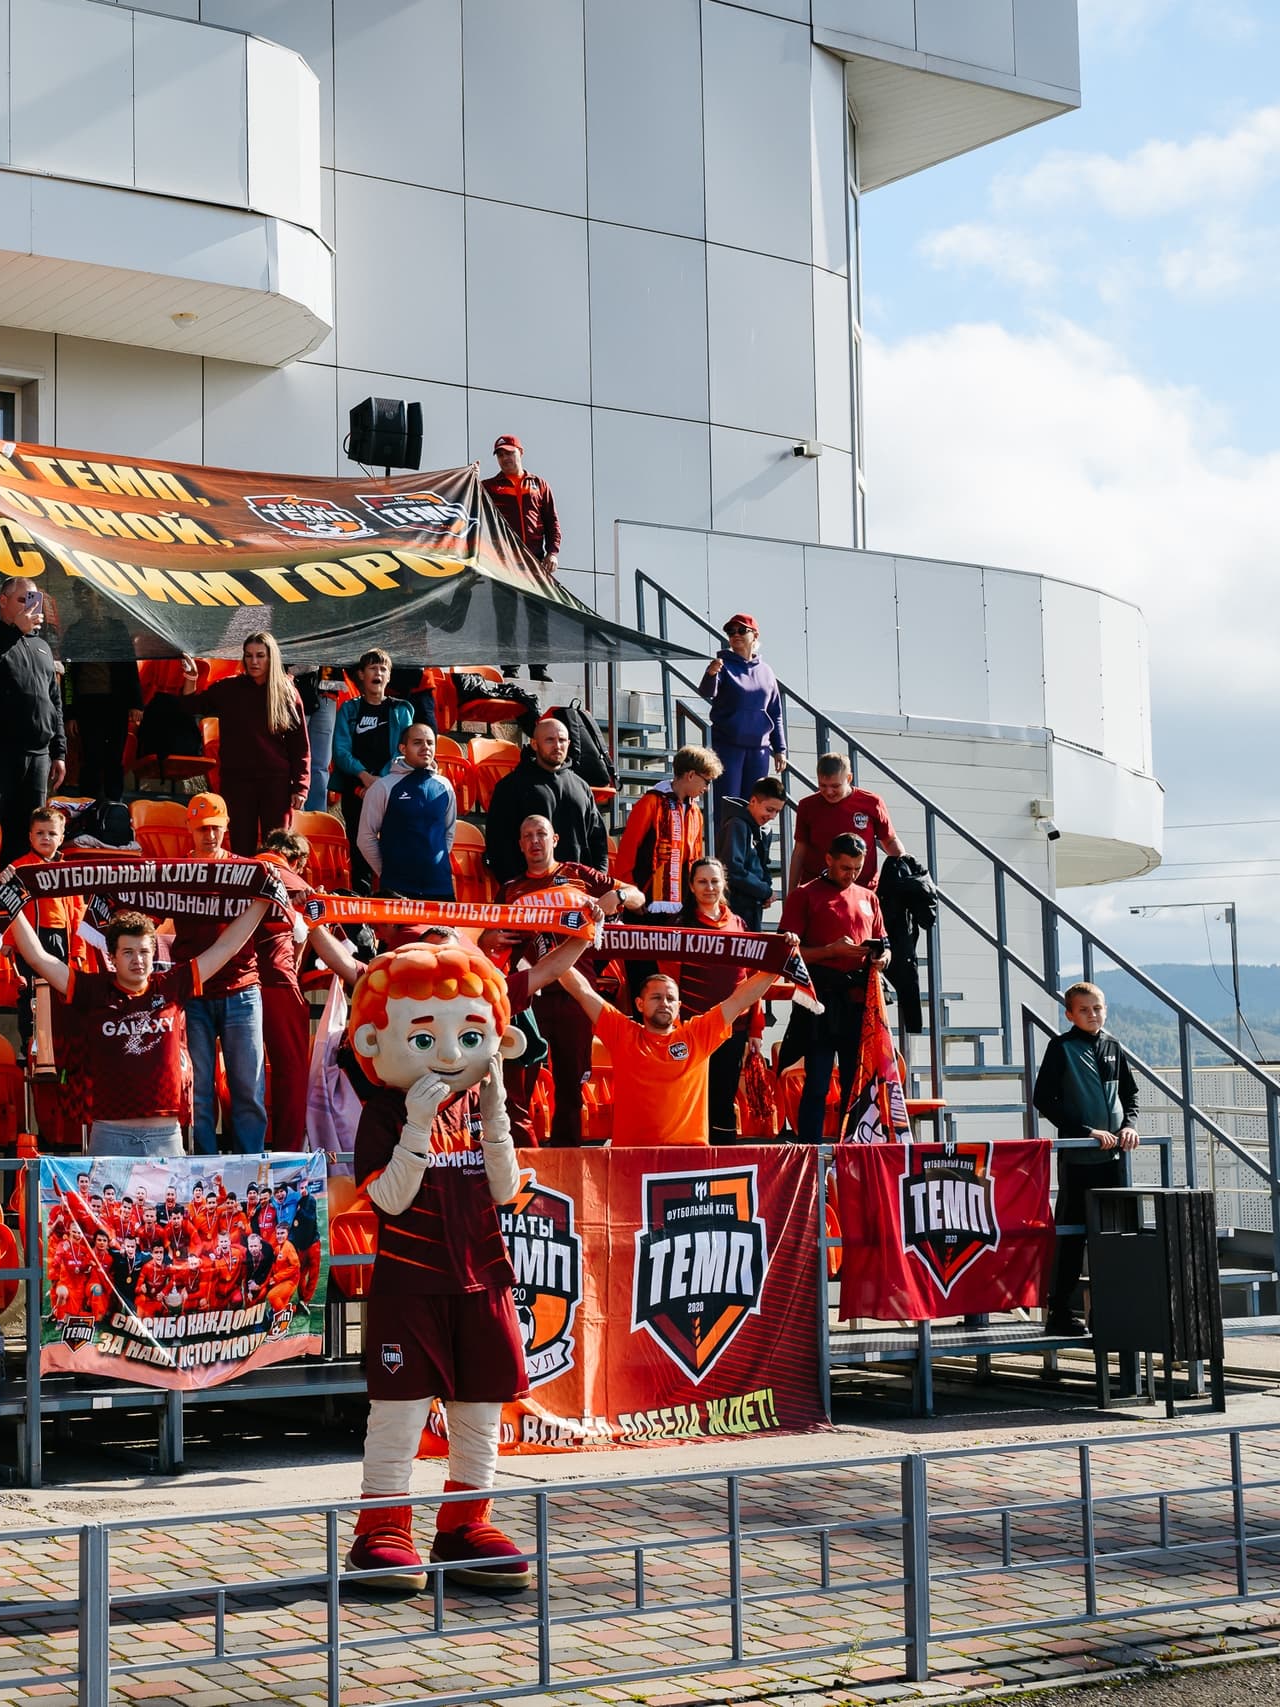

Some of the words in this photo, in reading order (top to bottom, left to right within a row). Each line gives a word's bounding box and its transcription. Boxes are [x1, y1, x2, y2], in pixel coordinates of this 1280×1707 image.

[21, 454, 211, 508] ТЕМП,
[261, 508, 349, 522] ТЕМП
[250, 550, 477, 604] ГОРО
[36, 861, 156, 890] ФУТБОЛЬНЫЙ
[161, 863, 208, 882] КЛУБ
[214, 864, 257, 886] ТЕМП
[331, 901, 377, 917] ТЕМП,
[384, 901, 431, 920] ТЕМП,
[438, 903, 501, 922] ТОЛЬКО
[507, 906, 554, 924] ТЕМП!
[686, 935, 725, 954] КЛУБ
[730, 937, 768, 960] ТЕМП
[102, 1017, 174, 1036] GALAXY
[923, 1158, 959, 1170] ФУТБОЛЬНЫЙ
[960, 1161, 974, 1171] КЛУБ
[666, 1202, 714, 1221] ФУТБОЛЬНЫЙ
[715, 1203, 735, 1216] КЛУБ
[910, 1180, 991, 1235] ТЕМП
[501, 1213, 554, 1239] НАТЫ
[649, 1231, 754, 1306] ТЕМП
[512, 1288, 526, 1301] 20
[687, 1301, 704, 1313] 2020
[111, 1311, 185, 1338] СПАСИБО
[187, 1303, 267, 1337] КАЖДОМУ
[66, 1327, 92, 1339] ТЕМП
[98, 1331, 125, 1355] ЗА
[619, 1403, 705, 1442] ПОБЕДА
[707, 1387, 780, 1435] ЖДЕТ!
